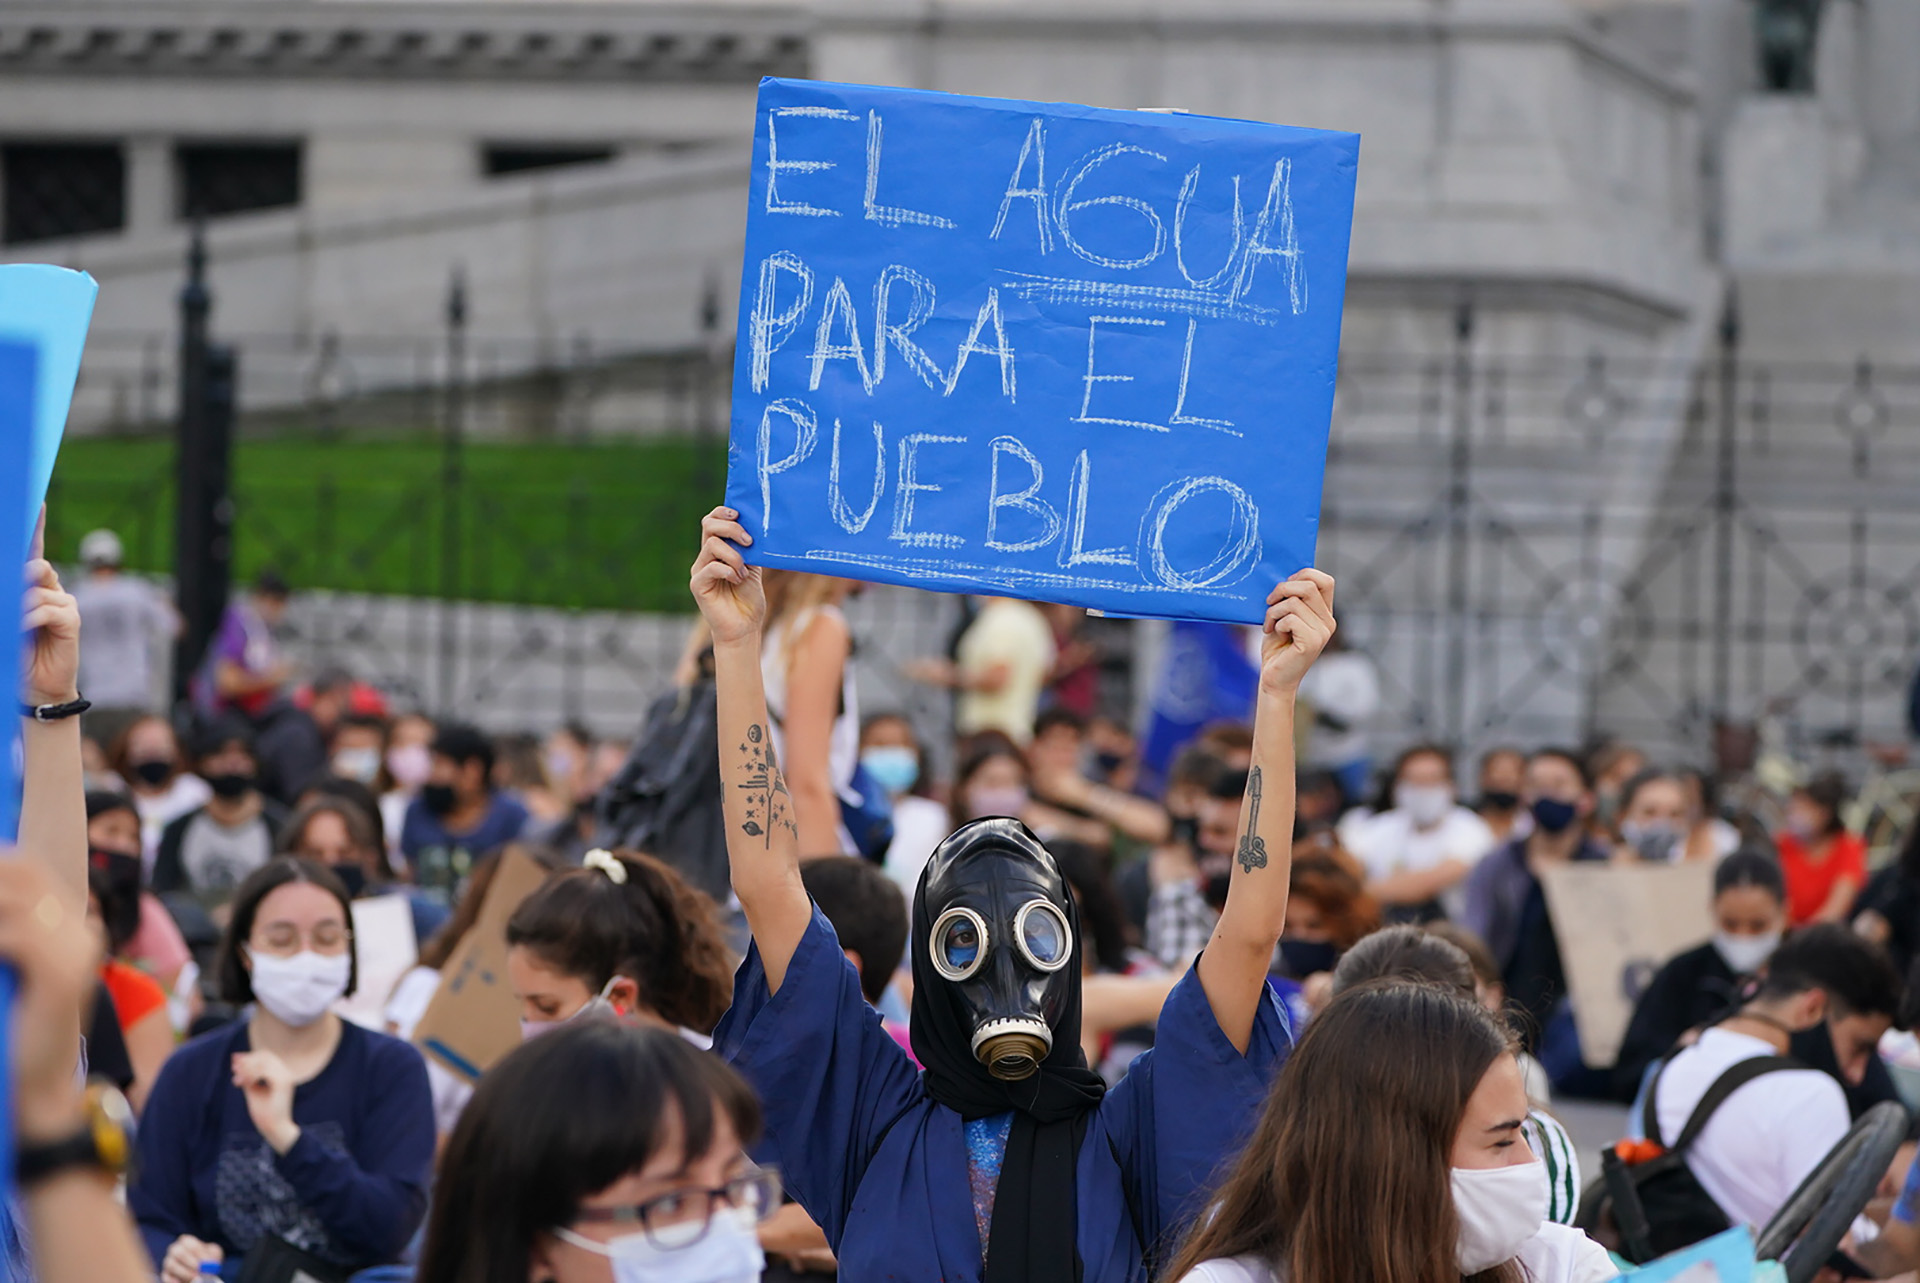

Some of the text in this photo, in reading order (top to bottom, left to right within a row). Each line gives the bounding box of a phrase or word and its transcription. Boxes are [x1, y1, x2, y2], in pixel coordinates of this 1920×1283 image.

[766, 107, 1308, 314] EL AGUA
[749, 250, 1243, 437] PARA EL
[756, 398, 1263, 590] PUEBLO
